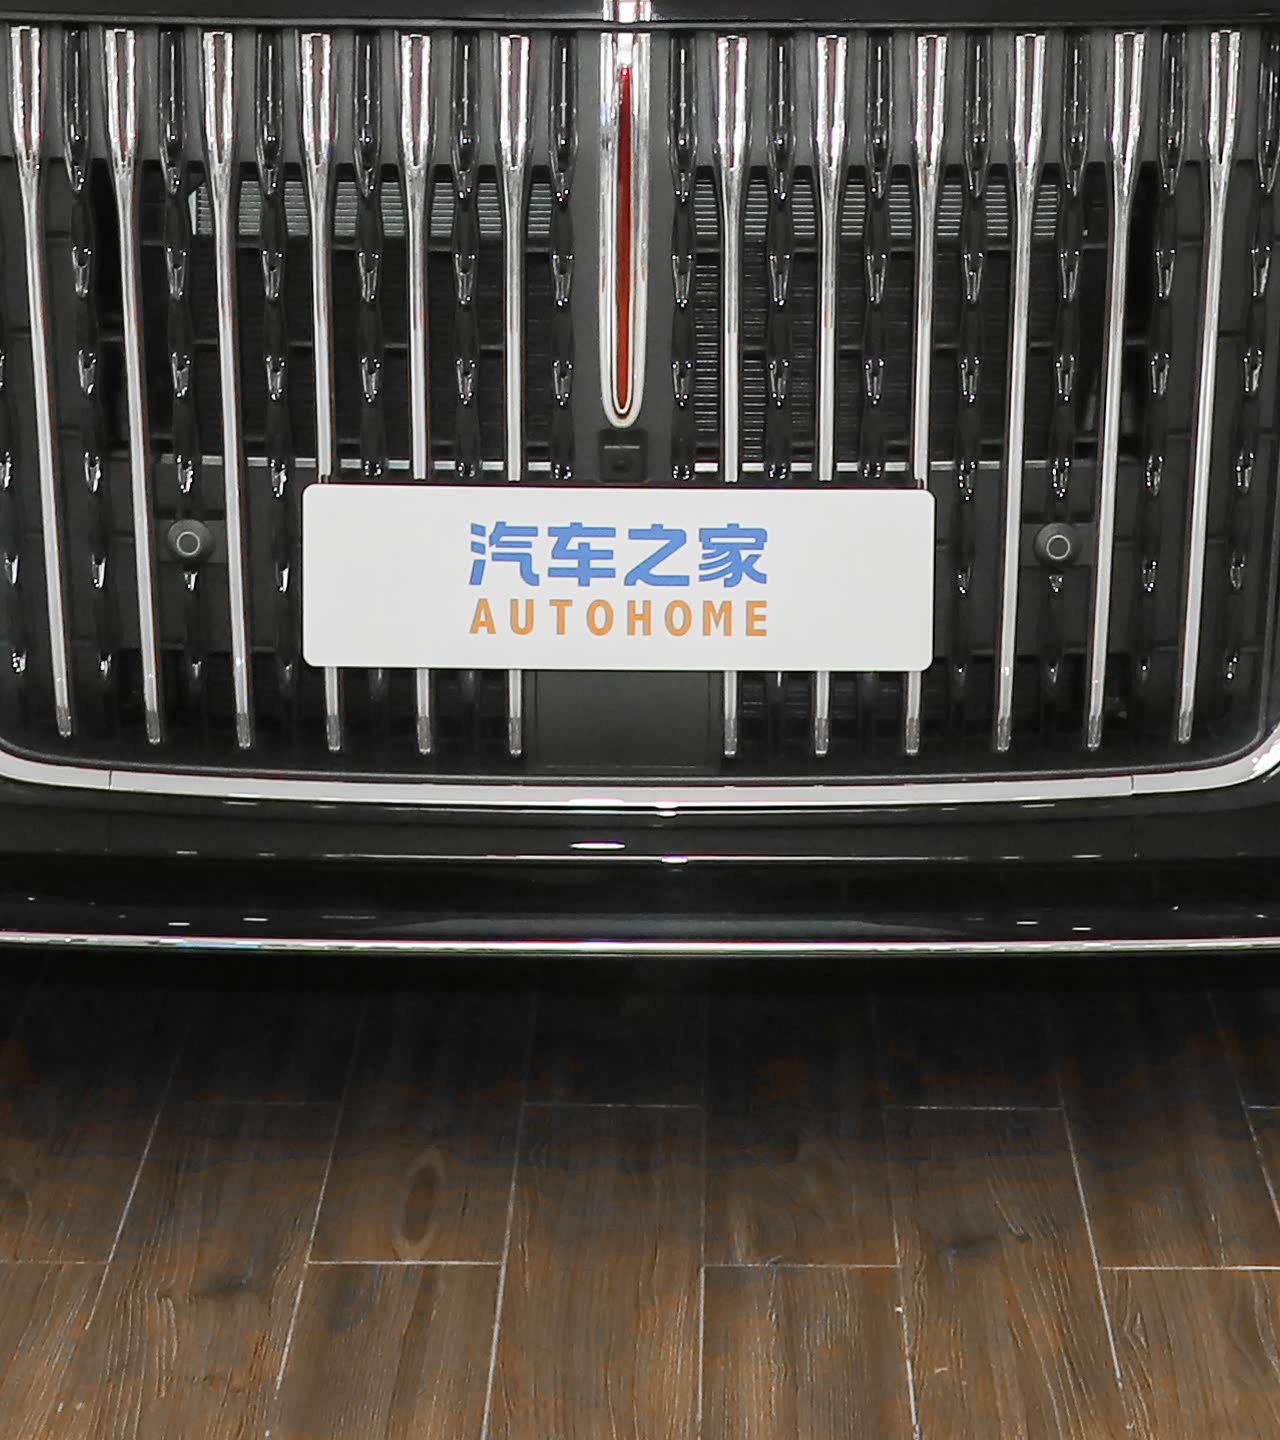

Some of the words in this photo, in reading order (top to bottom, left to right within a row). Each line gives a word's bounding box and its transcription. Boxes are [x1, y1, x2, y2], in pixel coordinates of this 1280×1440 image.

[468, 521, 768, 588] 汽车之家
[468, 597, 768, 638] AUTOHOME
